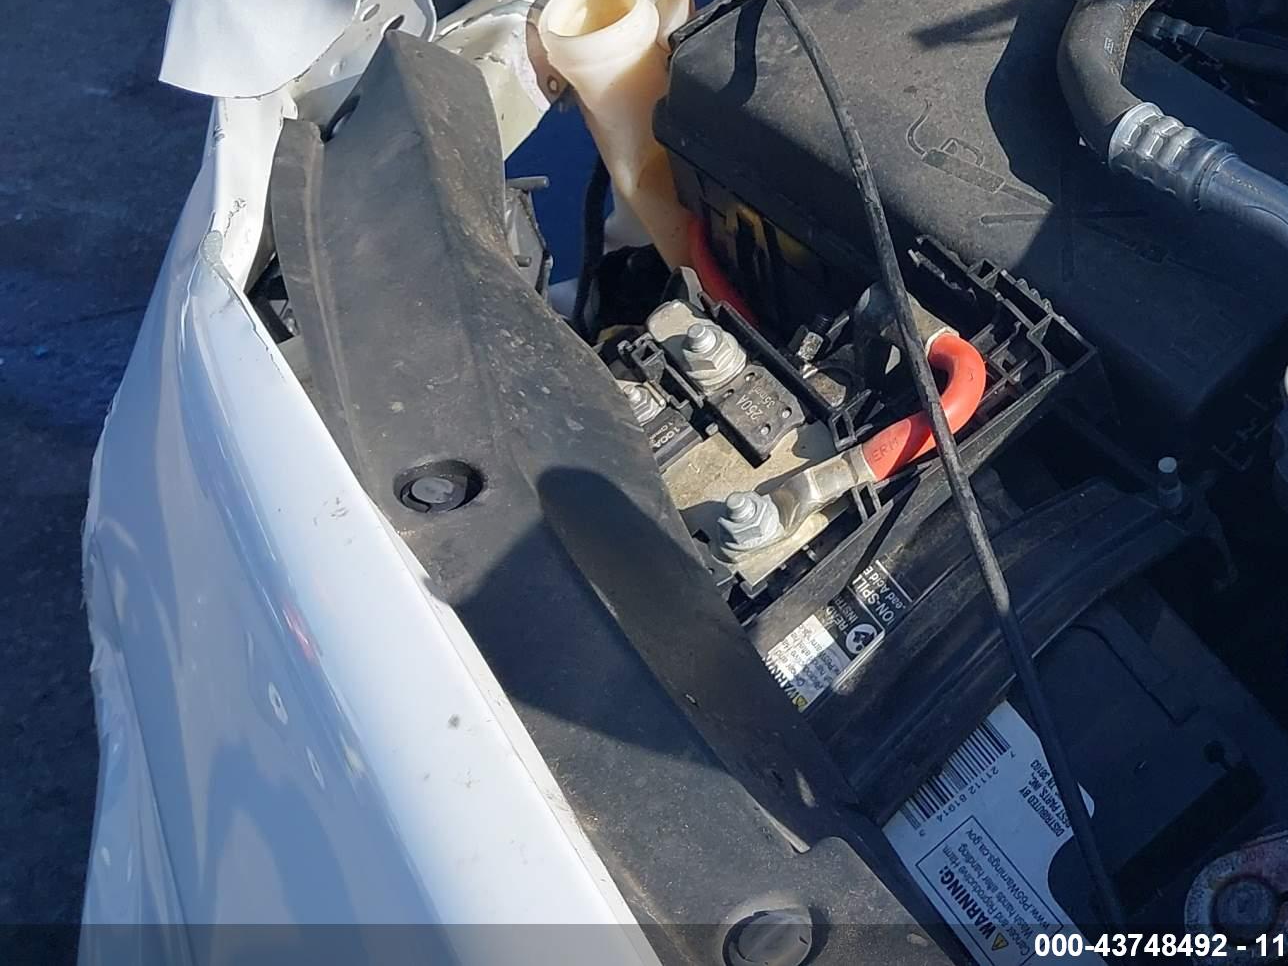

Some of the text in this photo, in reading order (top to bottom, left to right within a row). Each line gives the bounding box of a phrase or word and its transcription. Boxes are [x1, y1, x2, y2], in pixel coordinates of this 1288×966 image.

[735, 394, 763, 420] 250A
[868, 572, 889, 594] Acid
[884, 591, 905, 612] ead
[824, 604, 848, 630] READ
[967, 765, 999, 795] 21112
[1029, 758, 1050, 780] 38103
[1018, 785, 1064, 837] DISTRIBUTED BY
[957, 864, 998, 914] Reproductive
[965, 828, 1049, 930] www.P65Warnings.ca.gov
[980, 874, 998, 893] after
[934, 865, 997, 939] WARNING:
[994, 890, 1017, 916] hands
[993, 911, 1009, 927] and
[1010, 913, 1033, 939] Wash
[1005, 925, 1029, 956] Cancer
